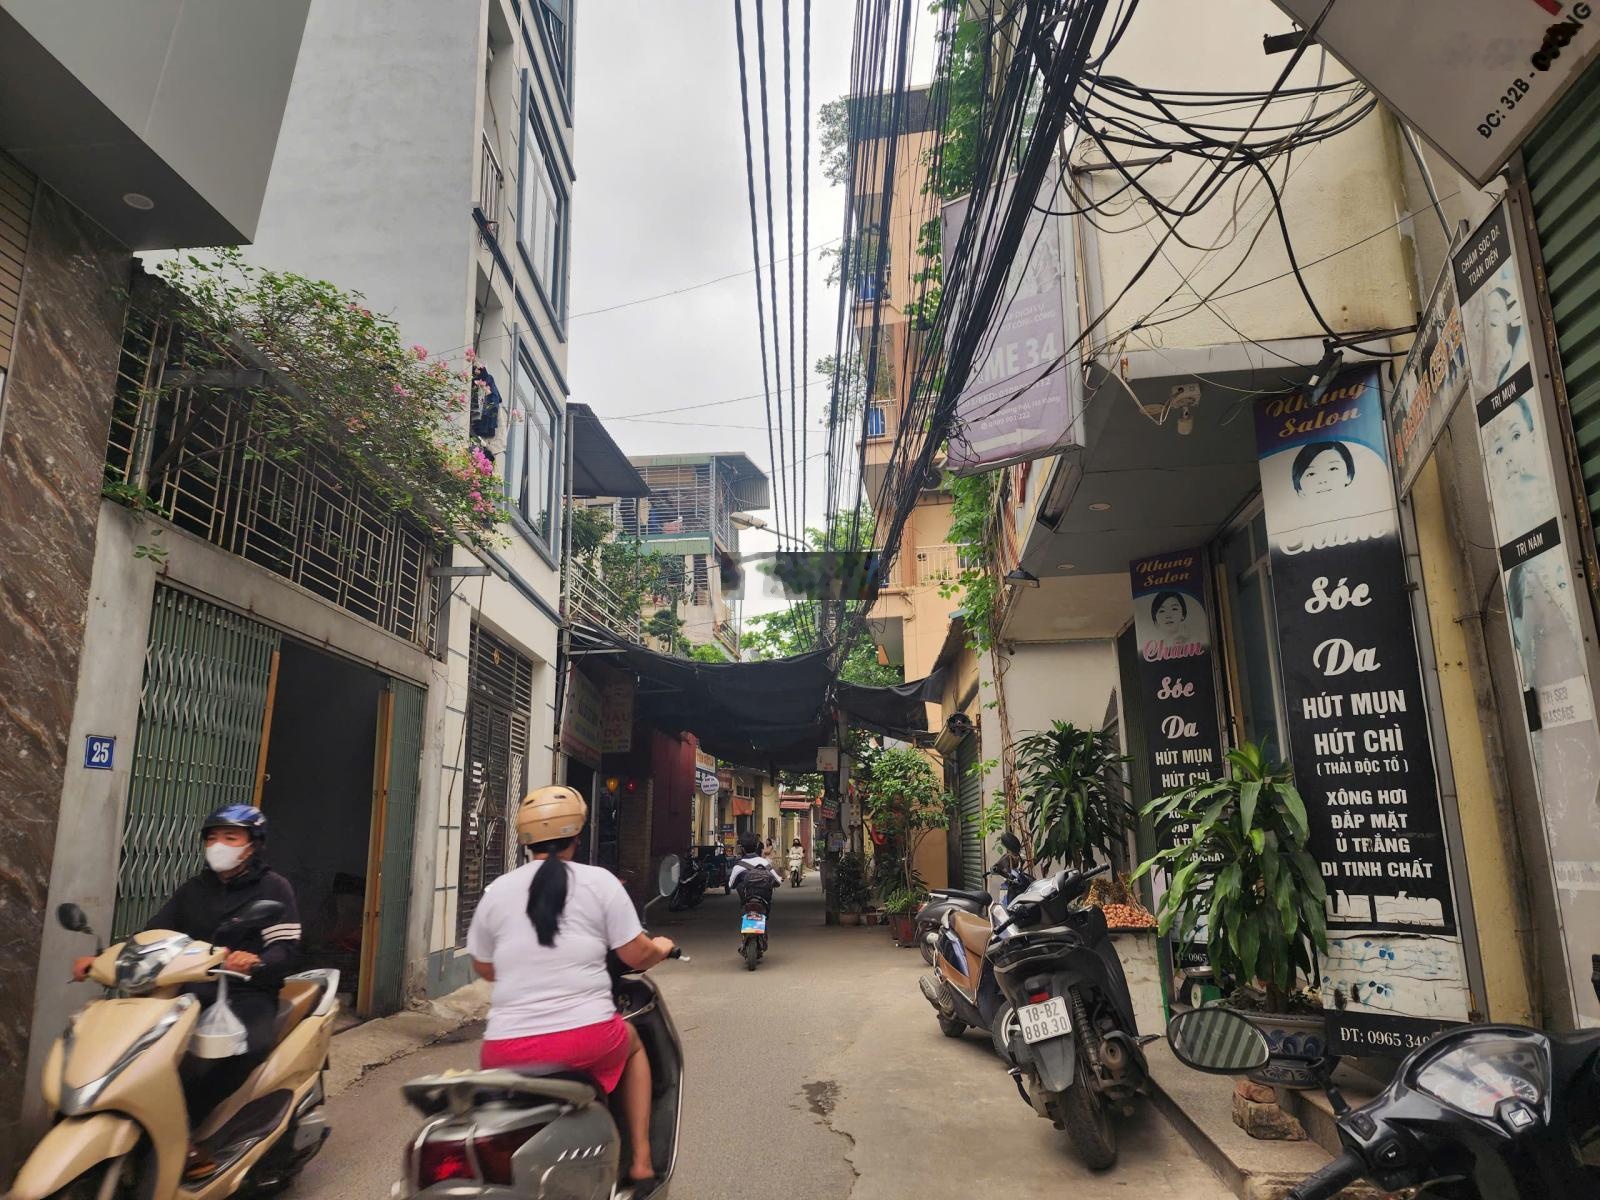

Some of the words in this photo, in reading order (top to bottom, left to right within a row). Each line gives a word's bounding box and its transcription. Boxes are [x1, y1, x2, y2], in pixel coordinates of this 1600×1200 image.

[1476, 109, 1506, 140] ĐC:
[1500, 77, 1530, 111] 32B
[1025, 332, 1058, 367] 34
[1491, 393, 1502, 410] TRỊ
[1501, 381, 1517, 403] MỤN
[1278, 407, 1362, 438] Salon
[1143, 570, 1191, 588] Salon
[1304, 575, 1373, 614] Sóc
[1312, 637, 1382, 677] Da
[1157, 676, 1196, 701] Sóc
[1302, 690, 1343, 720] HÚT
[1349, 689, 1406, 719] MỤN
[1161, 715, 1199, 740] Da
[1314, 728, 1356, 756] HÚT
[1364, 723, 1404, 752] CHÌ
[91, 742, 110, 763] 25
[1155, 747, 1179, 766] HÚT
[1182, 748, 1213, 766] MỤN
[1161, 770, 1185, 788] HÚT
[1355, 758, 1380, 776] ĐỘC
[1326, 788, 1373, 806] XÔNG
[1377, 788, 1408, 805] HƠI
[1330, 809, 1365, 830] ĐẮP
[1370, 811, 1408, 830] MẶT
[1336, 831, 1347, 853] Ủ
[1351, 833, 1411, 854] TRẮNG
[1342, 862, 1382, 877] TINH
[1387, 857, 1433, 879] CHẤT
[1025, 1002, 1060, 1023] 18-B2
[1025, 1016, 1068, 1041] 888.30
[1340, 1027, 1364, 1043] ĐT:
[1367, 1030, 1402, 1047] 0965
